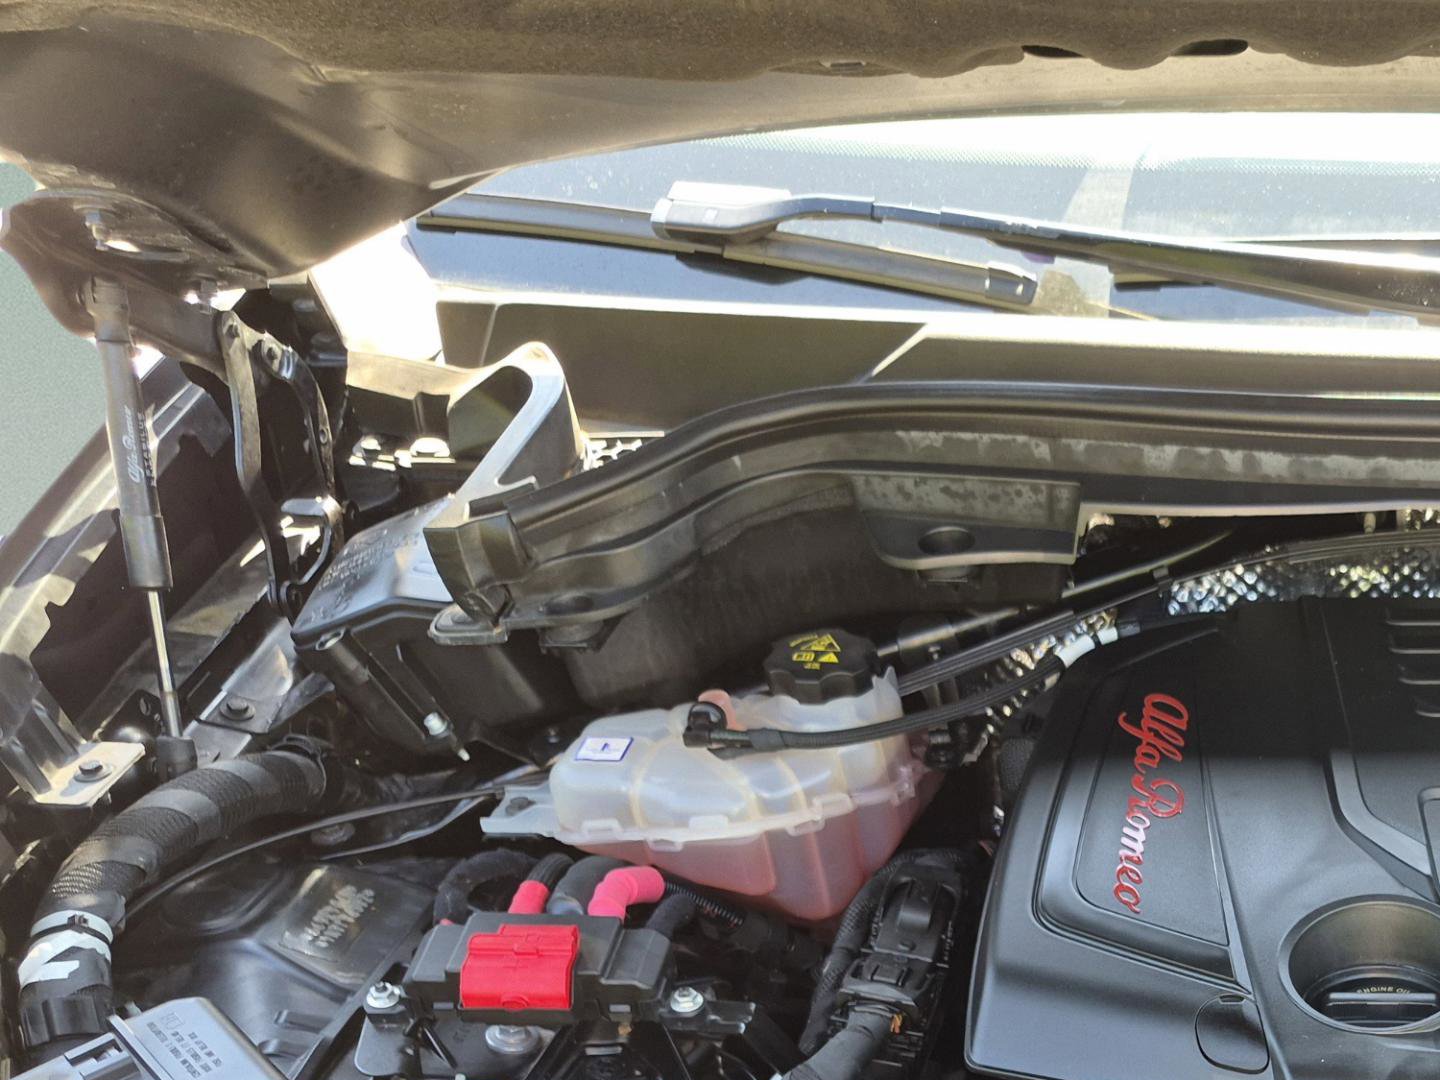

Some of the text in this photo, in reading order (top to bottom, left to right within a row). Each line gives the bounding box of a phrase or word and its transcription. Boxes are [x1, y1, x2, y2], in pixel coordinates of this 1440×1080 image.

[1113, 693, 1189, 914] Alfa Romeo
[1356, 986, 1394, 994] ENGINE
